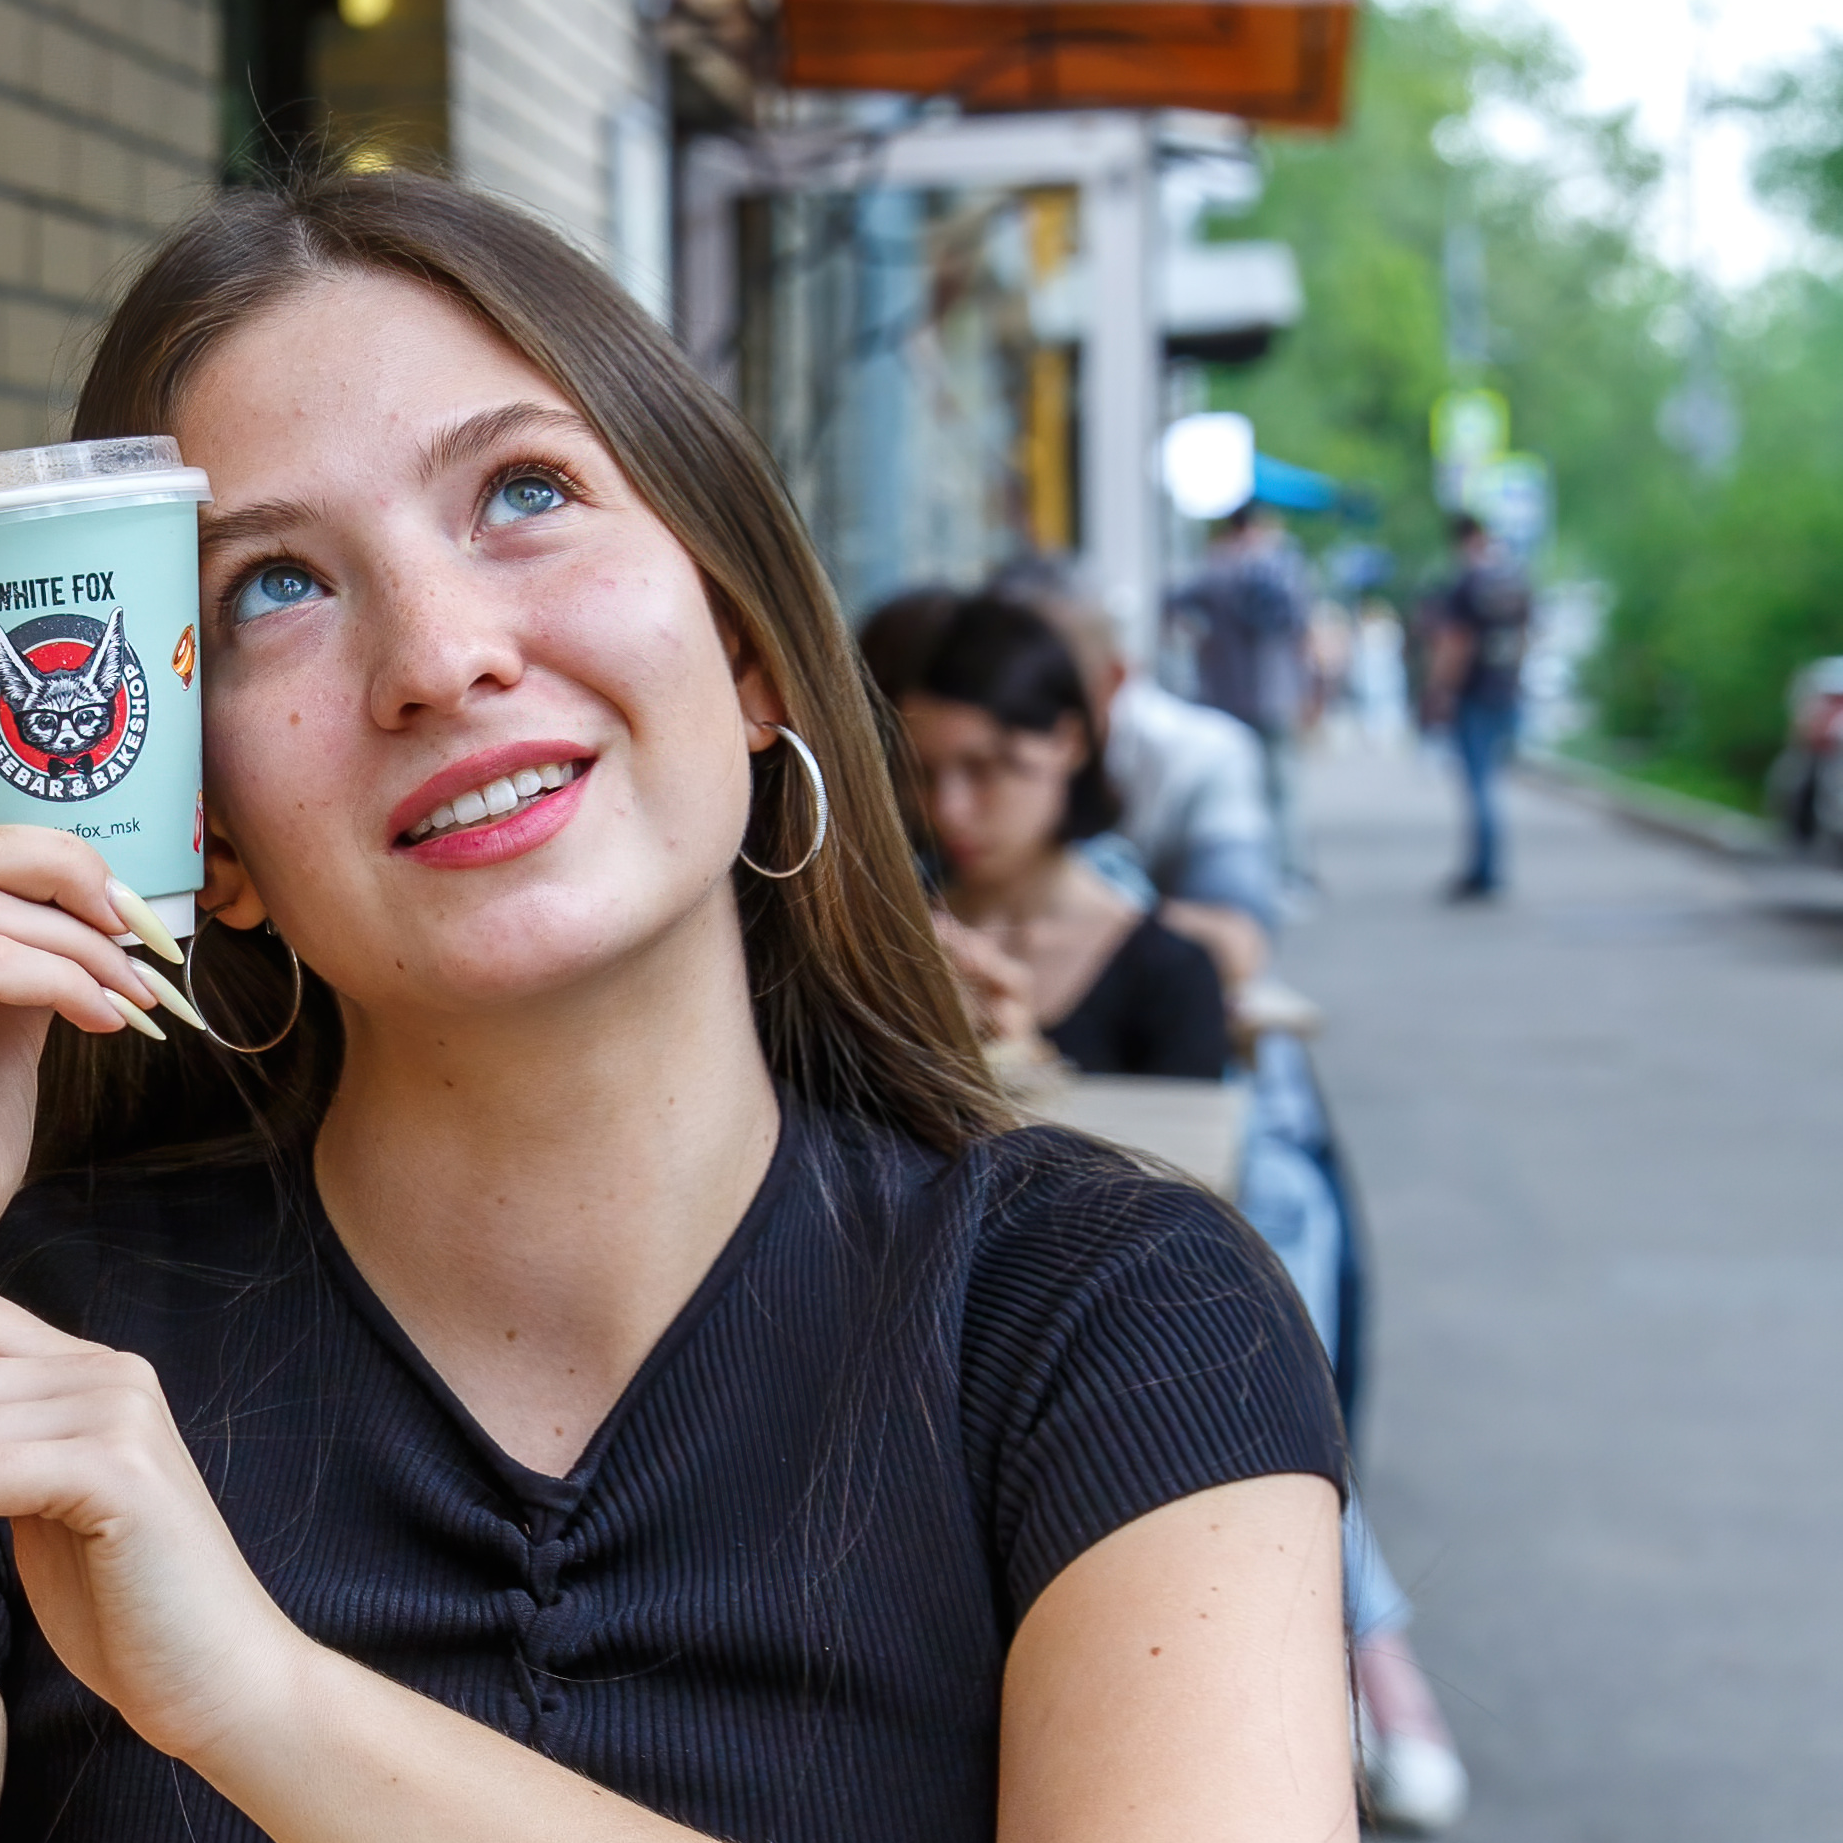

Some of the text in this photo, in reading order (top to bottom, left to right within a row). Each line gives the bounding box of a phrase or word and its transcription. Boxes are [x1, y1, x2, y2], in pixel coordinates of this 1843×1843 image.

[72, 571, 116, 604] FOX
[71, 779, 89, 798] &
[91, 663, 147, 791] BAKESHOP
